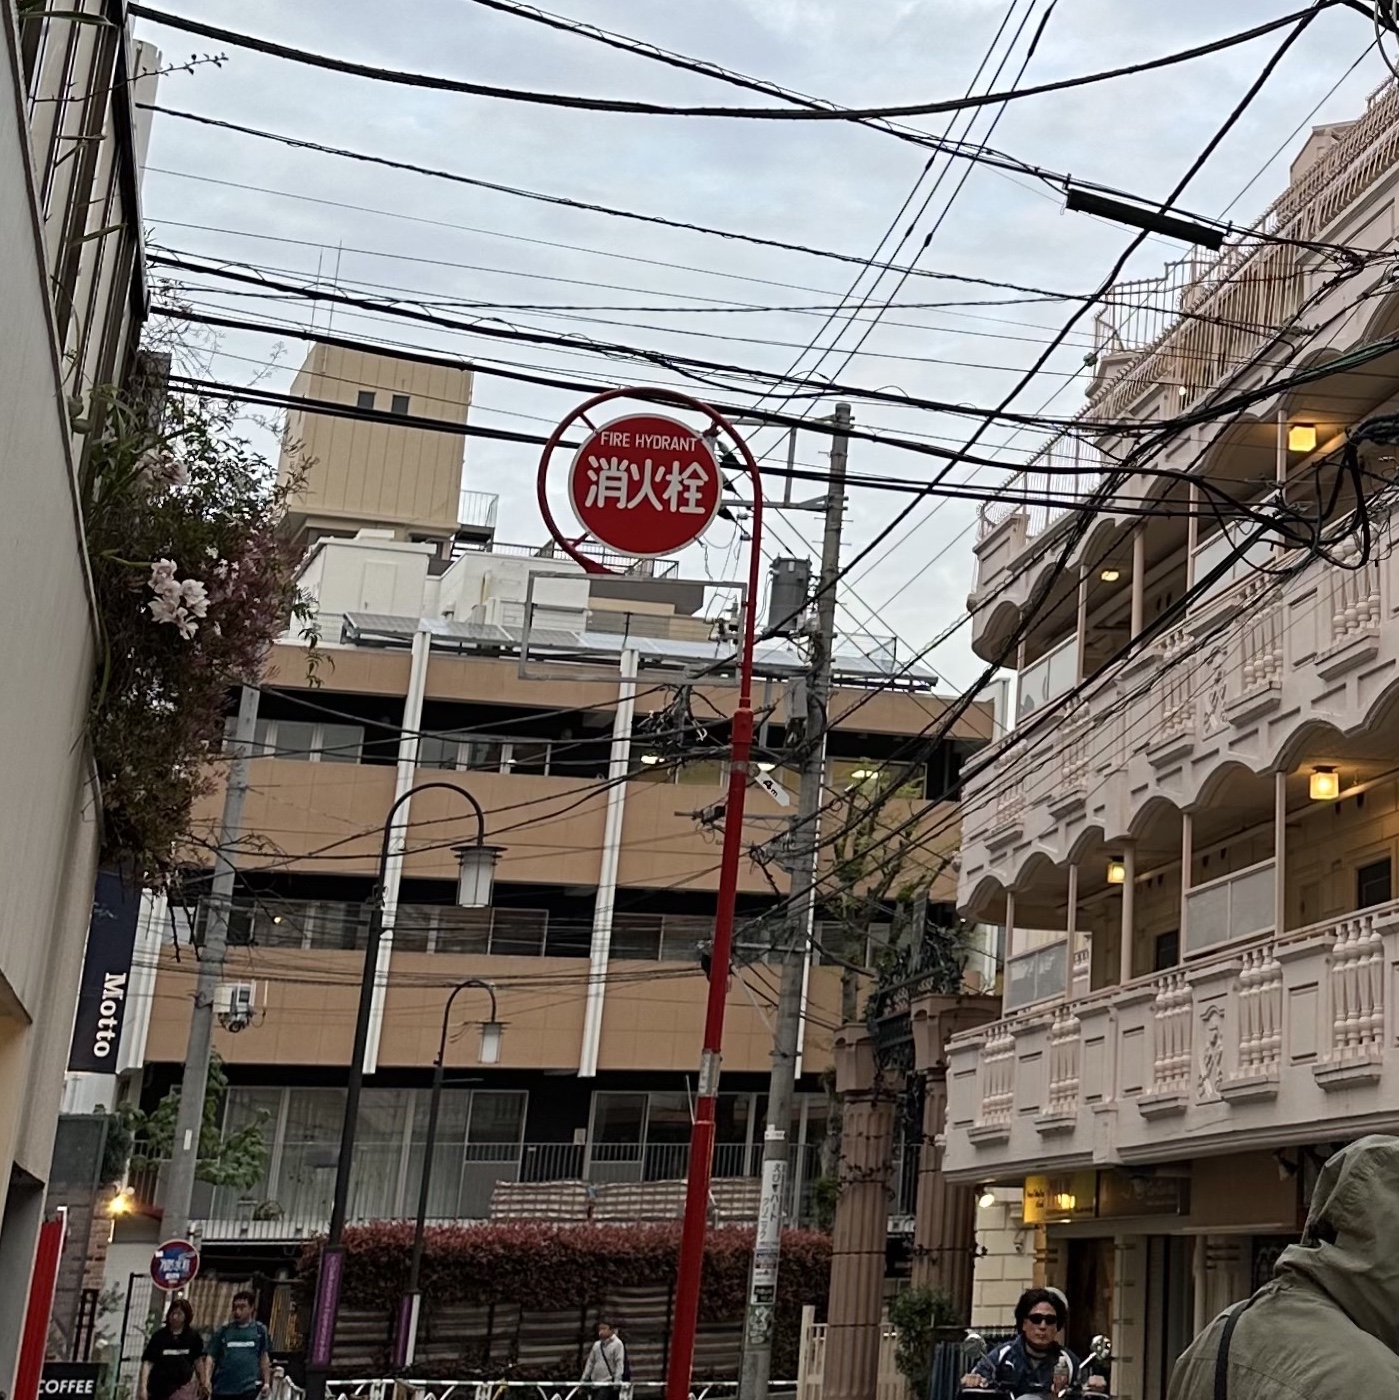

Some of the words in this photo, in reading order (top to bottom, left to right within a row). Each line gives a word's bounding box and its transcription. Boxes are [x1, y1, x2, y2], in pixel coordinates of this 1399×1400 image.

[601, 431, 631, 448] FIRE
[636, 434, 698, 452] HYDRANT
[585, 456, 710, 514] 消火栓
[93, 972, 127, 1058] Motto
